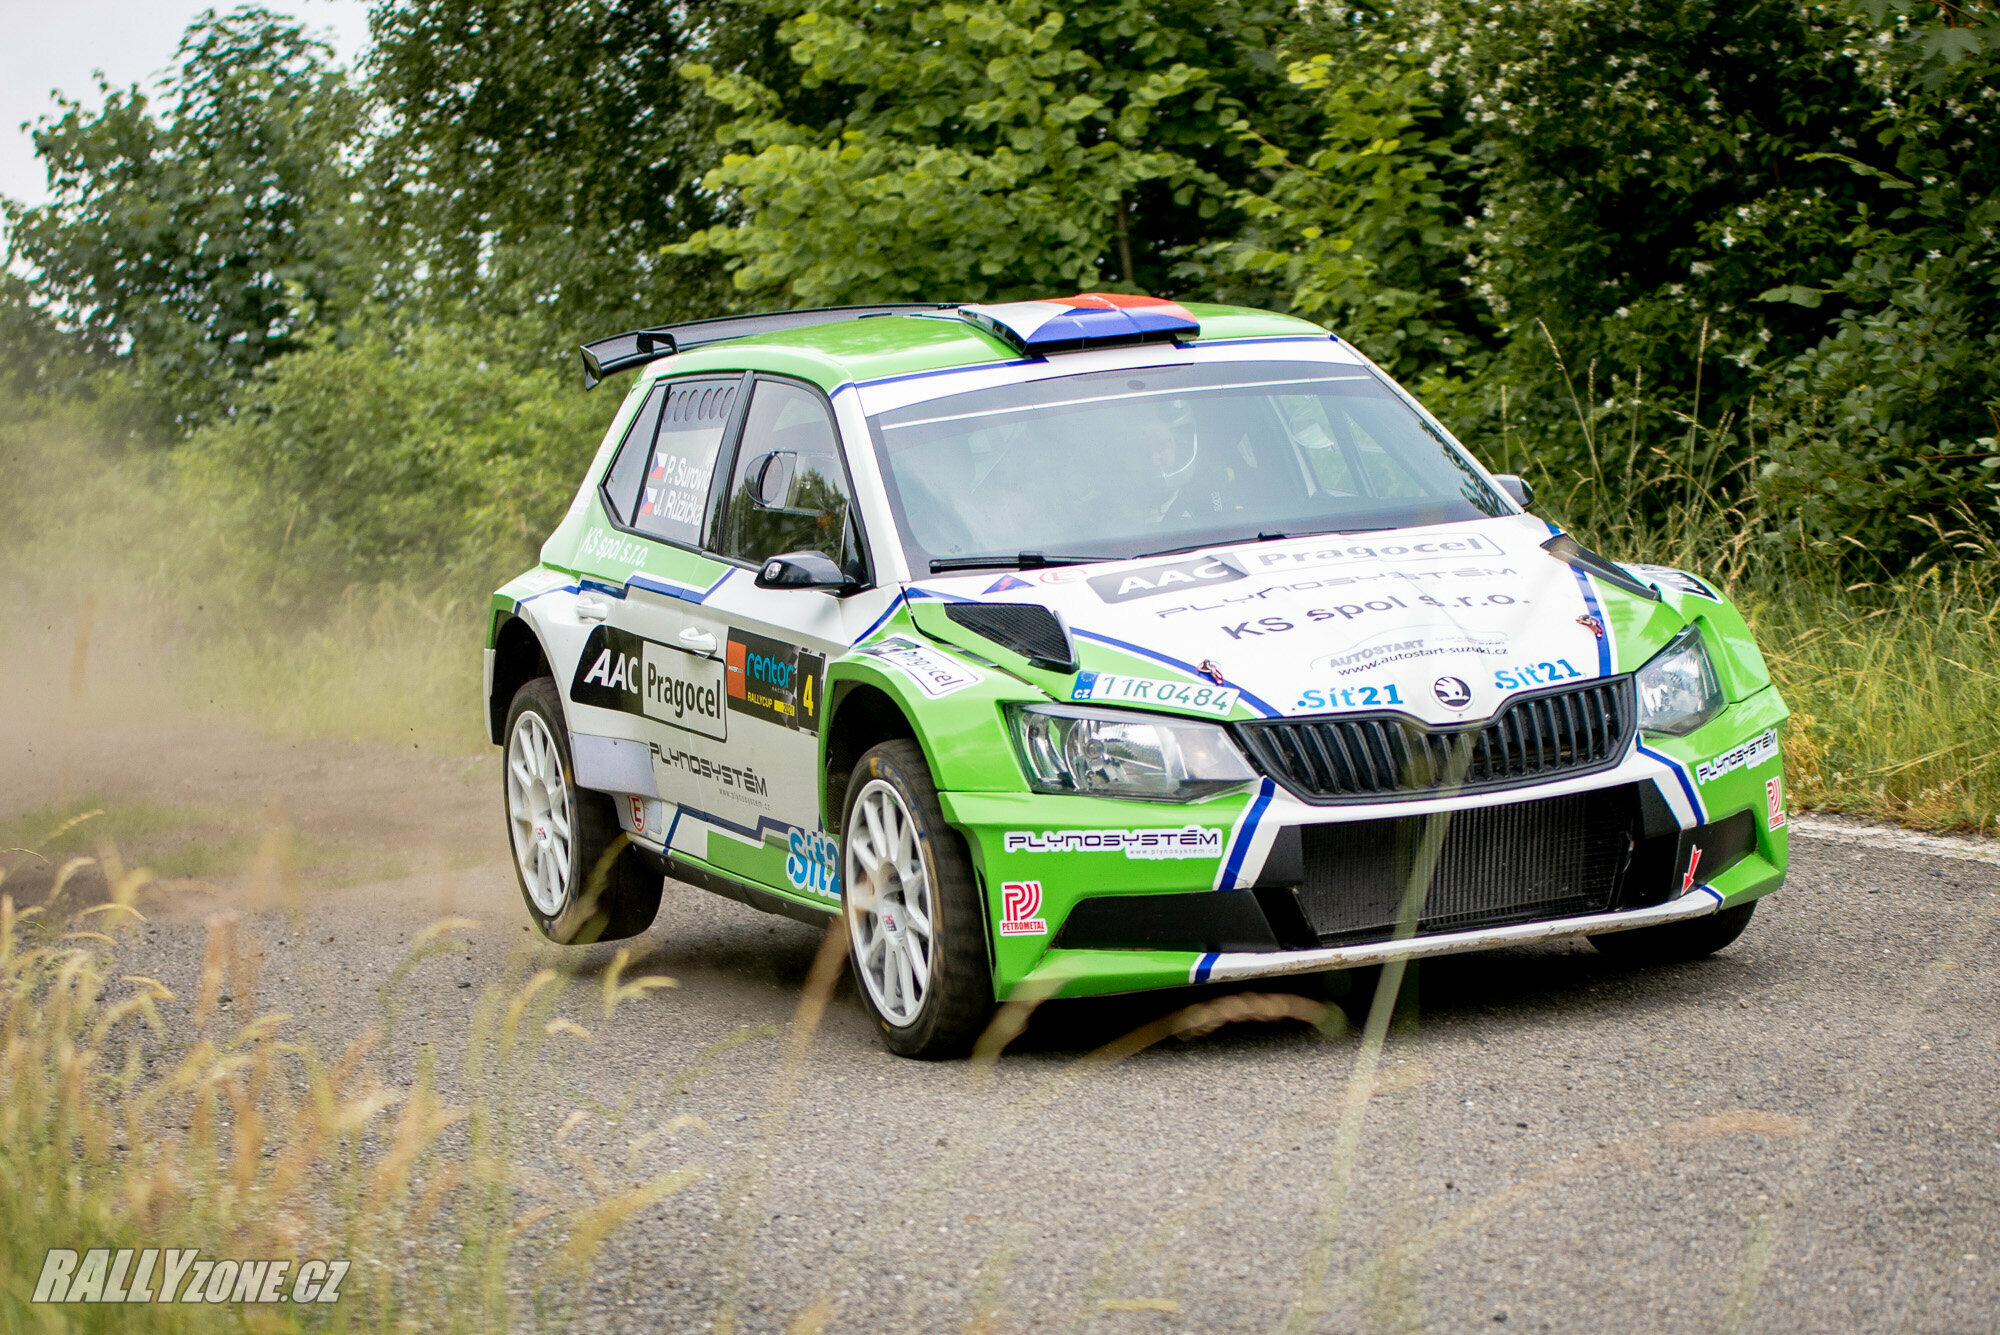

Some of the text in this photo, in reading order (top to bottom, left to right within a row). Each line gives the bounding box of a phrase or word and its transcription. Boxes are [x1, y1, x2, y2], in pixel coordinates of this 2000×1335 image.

[664, 455, 677, 484] P.
[653, 488, 666, 517] J.
[580, 526, 648, 568] KS spol s.r.o.
[1117, 537, 1484, 595] AAC Pragocel
[1221, 593, 1531, 640] KS spol s.r.o.
[1329, 639, 1425, 668] AUTOSTART
[1337, 644, 1509, 676] www.autostart-suzuki.cz
[584, 648, 721, 720] AAC Pragocel
[746, 652, 796, 689] rentor
[747, 692, 773, 709] RALLYCUP
[803, 674, 814, 717] 4
[1073, 689, 1091, 699] CZ
[1009, 829, 1218, 848] PLYNOSYSTÉM
[789, 831, 841, 895] Síť2
[1002, 920, 1045, 932] PETROMETAL
